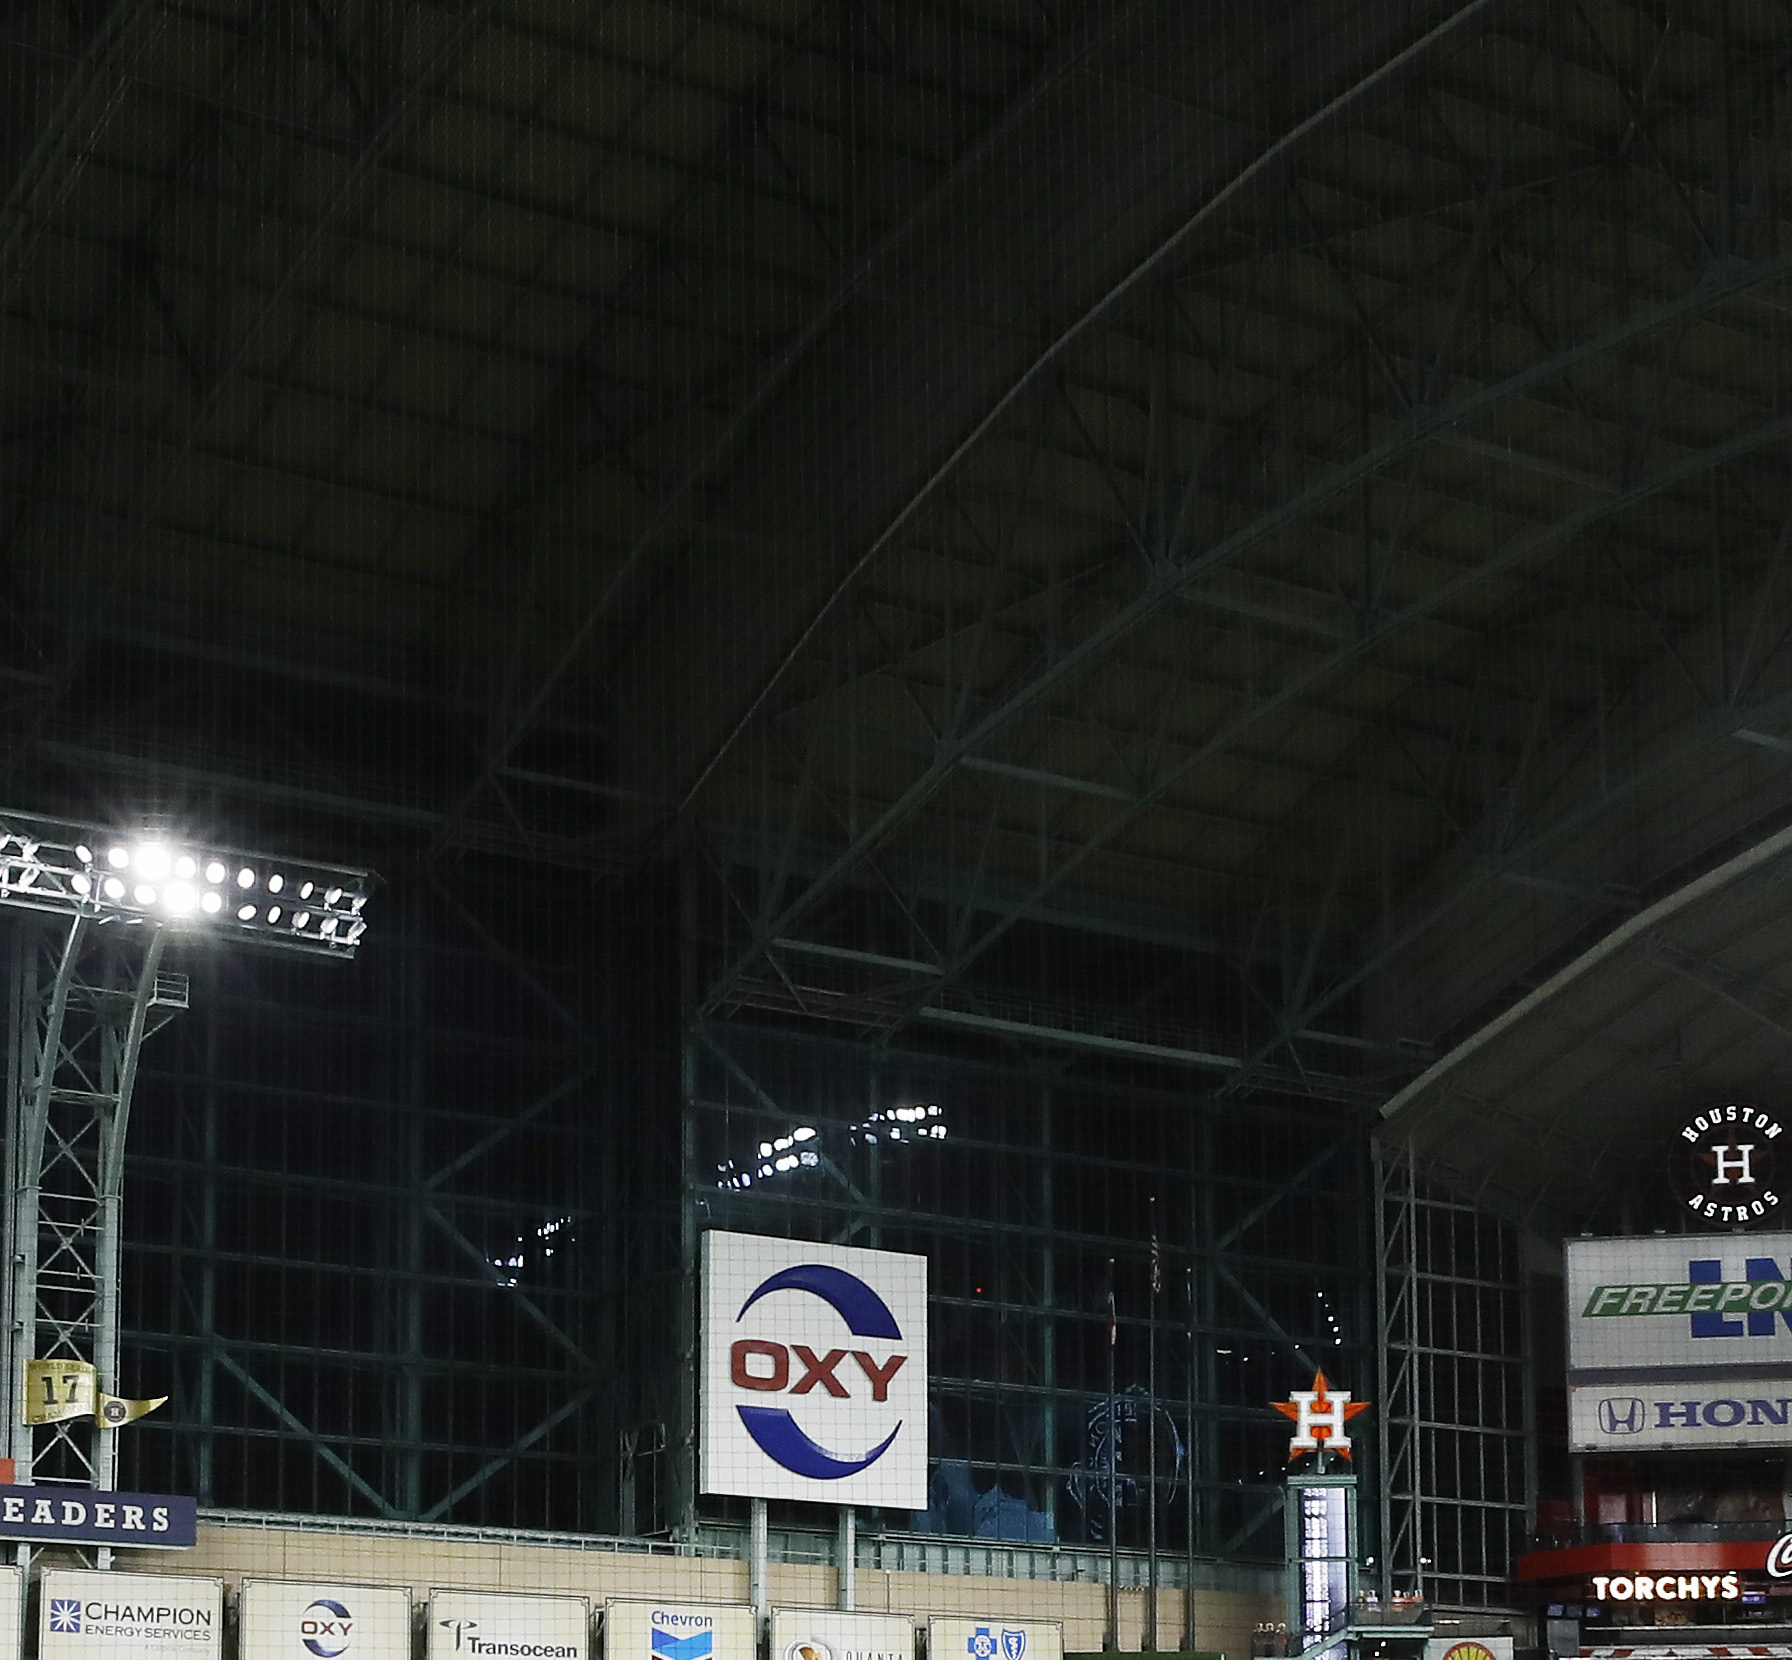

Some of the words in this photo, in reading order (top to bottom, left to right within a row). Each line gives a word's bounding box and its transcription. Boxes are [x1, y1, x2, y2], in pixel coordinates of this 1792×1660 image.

[1683, 1106, 1783, 1144] HOUSTON
[1712, 1143, 1756, 1184] H
[1688, 1190, 1779, 1223] ASTROS
[731, 1340, 909, 1402] OXY
[42, 1376, 79, 1405] 17
[85, 1601, 212, 1626] CHAMPION
[651, 1610, 713, 1628] Chevron
[85, 1625, 142, 1637] ENERGY
[144, 1627, 212, 1641] SERVICES
[301, 1620, 353, 1637] OXY
[467, 1636, 578, 1659] Transocean
